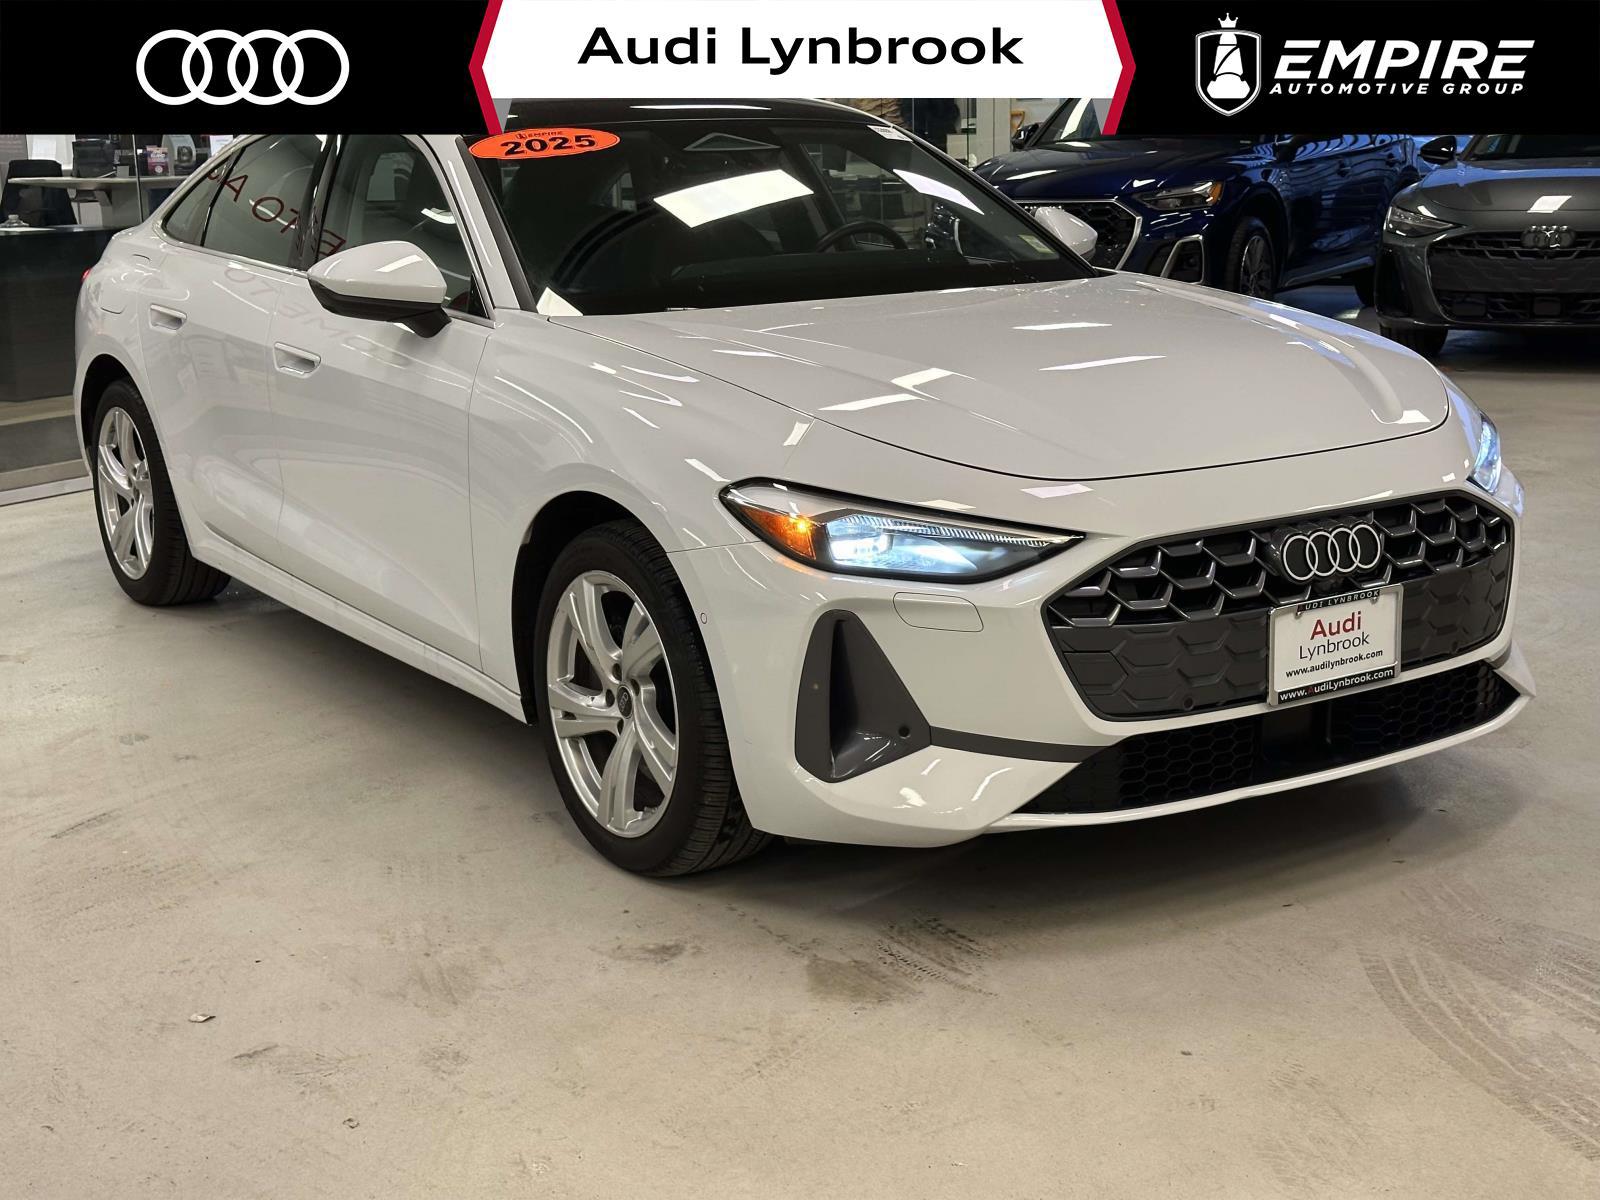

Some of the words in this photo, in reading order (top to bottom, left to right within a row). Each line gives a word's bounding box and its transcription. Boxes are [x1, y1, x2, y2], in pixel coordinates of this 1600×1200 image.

[500, 135, 596, 157] 2025
[1327, 589, 1379, 606] LYNBROOK
[1310, 611, 1362, 641] Audi
[1299, 631, 1370, 661] Lynbrook
[1285, 649, 1383, 678] www.audilynbrook.com
[1279, 668, 1394, 701] www.AudiLynbrook.com
